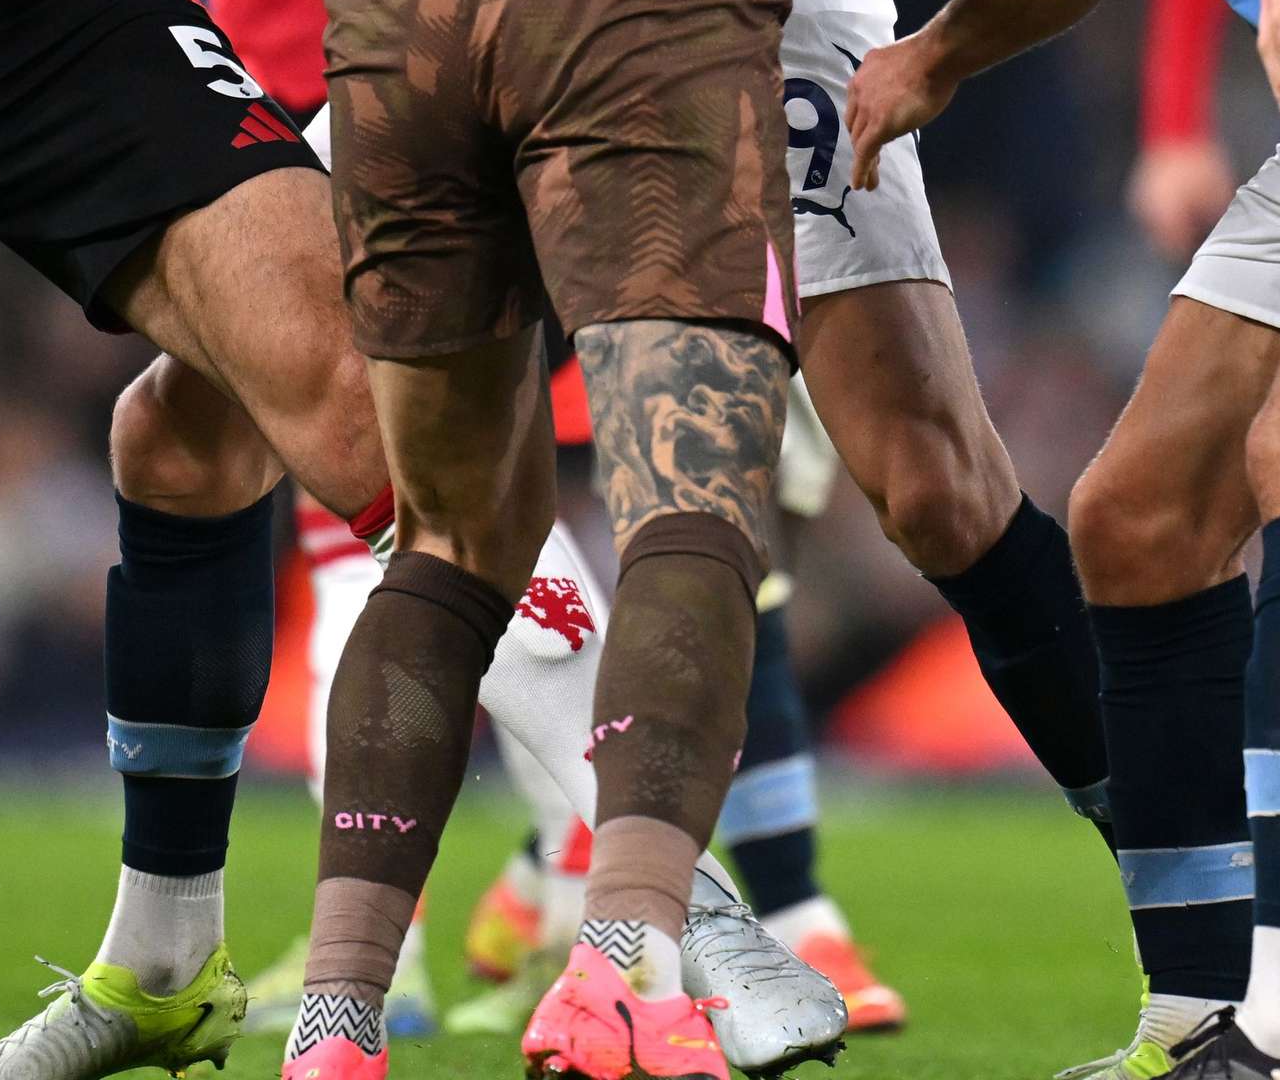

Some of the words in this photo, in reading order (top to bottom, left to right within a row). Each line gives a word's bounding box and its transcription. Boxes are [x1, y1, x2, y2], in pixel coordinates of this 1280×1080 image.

[168, 25, 265, 99] 5
[783, 77, 840, 191] 9
[334, 811, 418, 833] CITY
